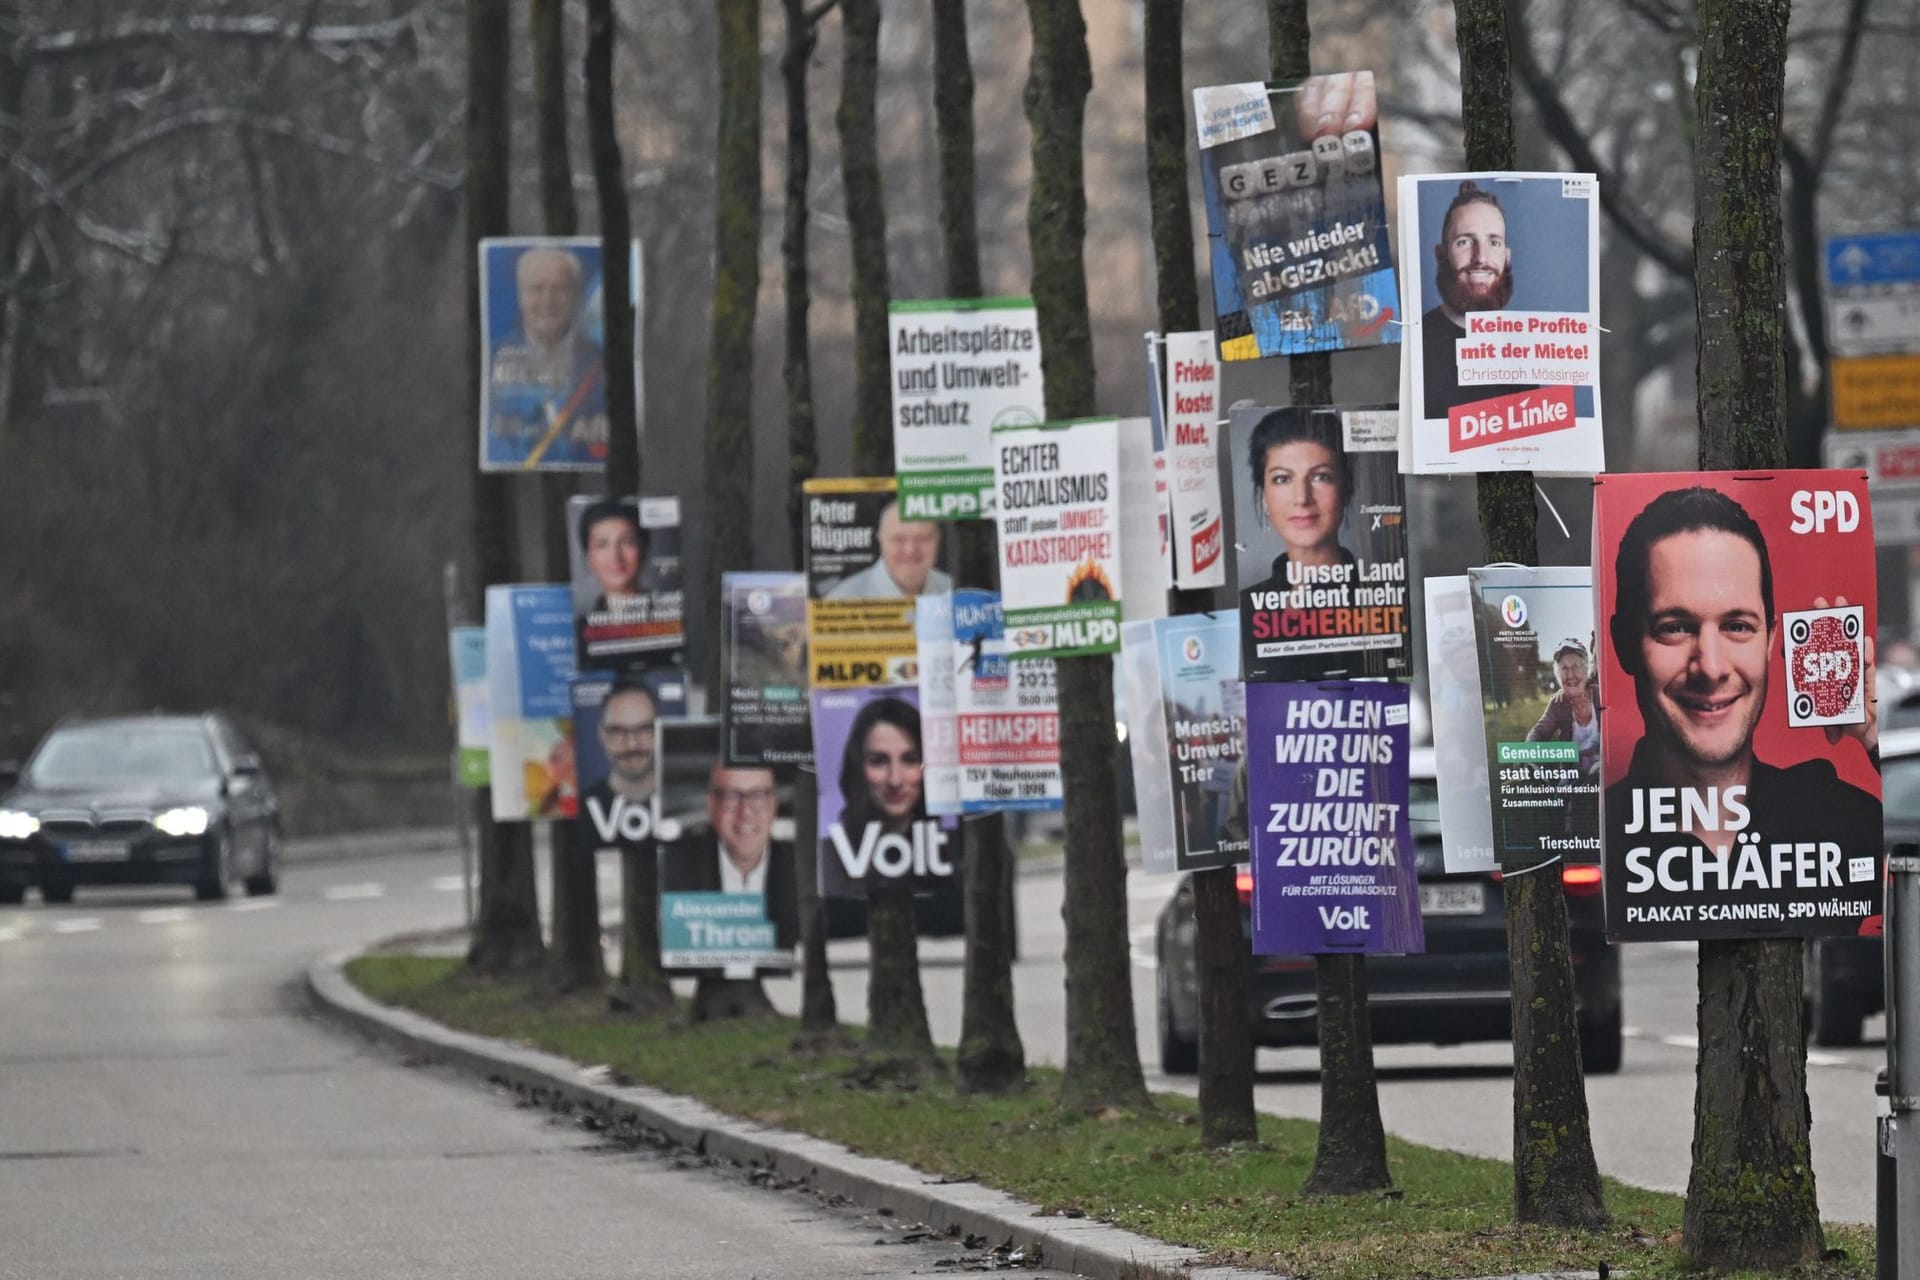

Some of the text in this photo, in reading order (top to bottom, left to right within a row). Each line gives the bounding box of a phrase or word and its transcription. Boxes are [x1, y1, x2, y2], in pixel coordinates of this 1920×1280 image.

[1243, 222, 1366, 271] Nie wieder
[1252, 243, 1380, 298] abGEZockt!
[1470, 316, 1588, 334] Keine Profite
[897, 325, 1033, 357] Arbeitsplätze
[1461, 343, 1588, 360] mit der Miete!
[899, 359, 1030, 392] und Umwelt-
[1462, 367, 1590, 384] Christoph Mössinger
[900, 399, 970, 428] schutz
[1460, 397, 1568, 441] Die Linke
[1175, 422, 1210, 448] Mut,
[1001, 443, 1060, 476] ECHTER
[904, 492, 978, 518] MLPD
[1003, 472, 1108, 511] SOZIALISMUS
[810, 499, 856, 524] Peter
[1005, 516, 1028, 534] statt
[1060, 508, 1109, 531] UMWELT-
[1790, 490, 1860, 533] SPD
[811, 524, 873, 552] Rügner
[1006, 532, 1112, 568] KATASTROPHE!
[1286, 558, 1405, 585] Unser Land
[1251, 583, 1405, 611] verdient mehr
[1055, 619, 1119, 648] MLPD
[1252, 606, 1408, 639] SICHERHEIT.
[817, 662, 882, 683] MLPD
[1803, 650, 1853, 684] SPD
[1175, 716, 1241, 739] Mensch
[1286, 700, 1382, 729] HOLEN
[1176, 739, 1243, 762] Umwelt
[1275, 734, 1393, 765] WIR UNS
[1501, 746, 1576, 760] Gemeinsam
[1179, 766, 1214, 784] Tier
[1315, 768, 1365, 797] DIE
[1499, 767, 1579, 781] statt einsam
[1501, 785, 1515, 794] Für
[1516, 784, 1555, 794] Inklusion
[1556, 784, 1573, 794] und
[1502, 797, 1564, 808] Zusammenhalt
[1266, 803, 1400, 833] ZUKUNFT
[1624, 784, 1751, 835] JENS
[828, 819, 953, 880] Volt
[1276, 831, 1397, 867] ZURÜCK
[1625, 833, 1844, 894] SCHÄFER
[1282, 885, 1397, 897] FÜR ECHTEN KLIMASCHUTZ
[1310, 873, 1375, 886] MIT LÖSUNGEN
[1318, 905, 1371, 930] Volt
[1626, 900, 1872, 923] PLAKAT SCANNEN, SPD WÄHLEN!
